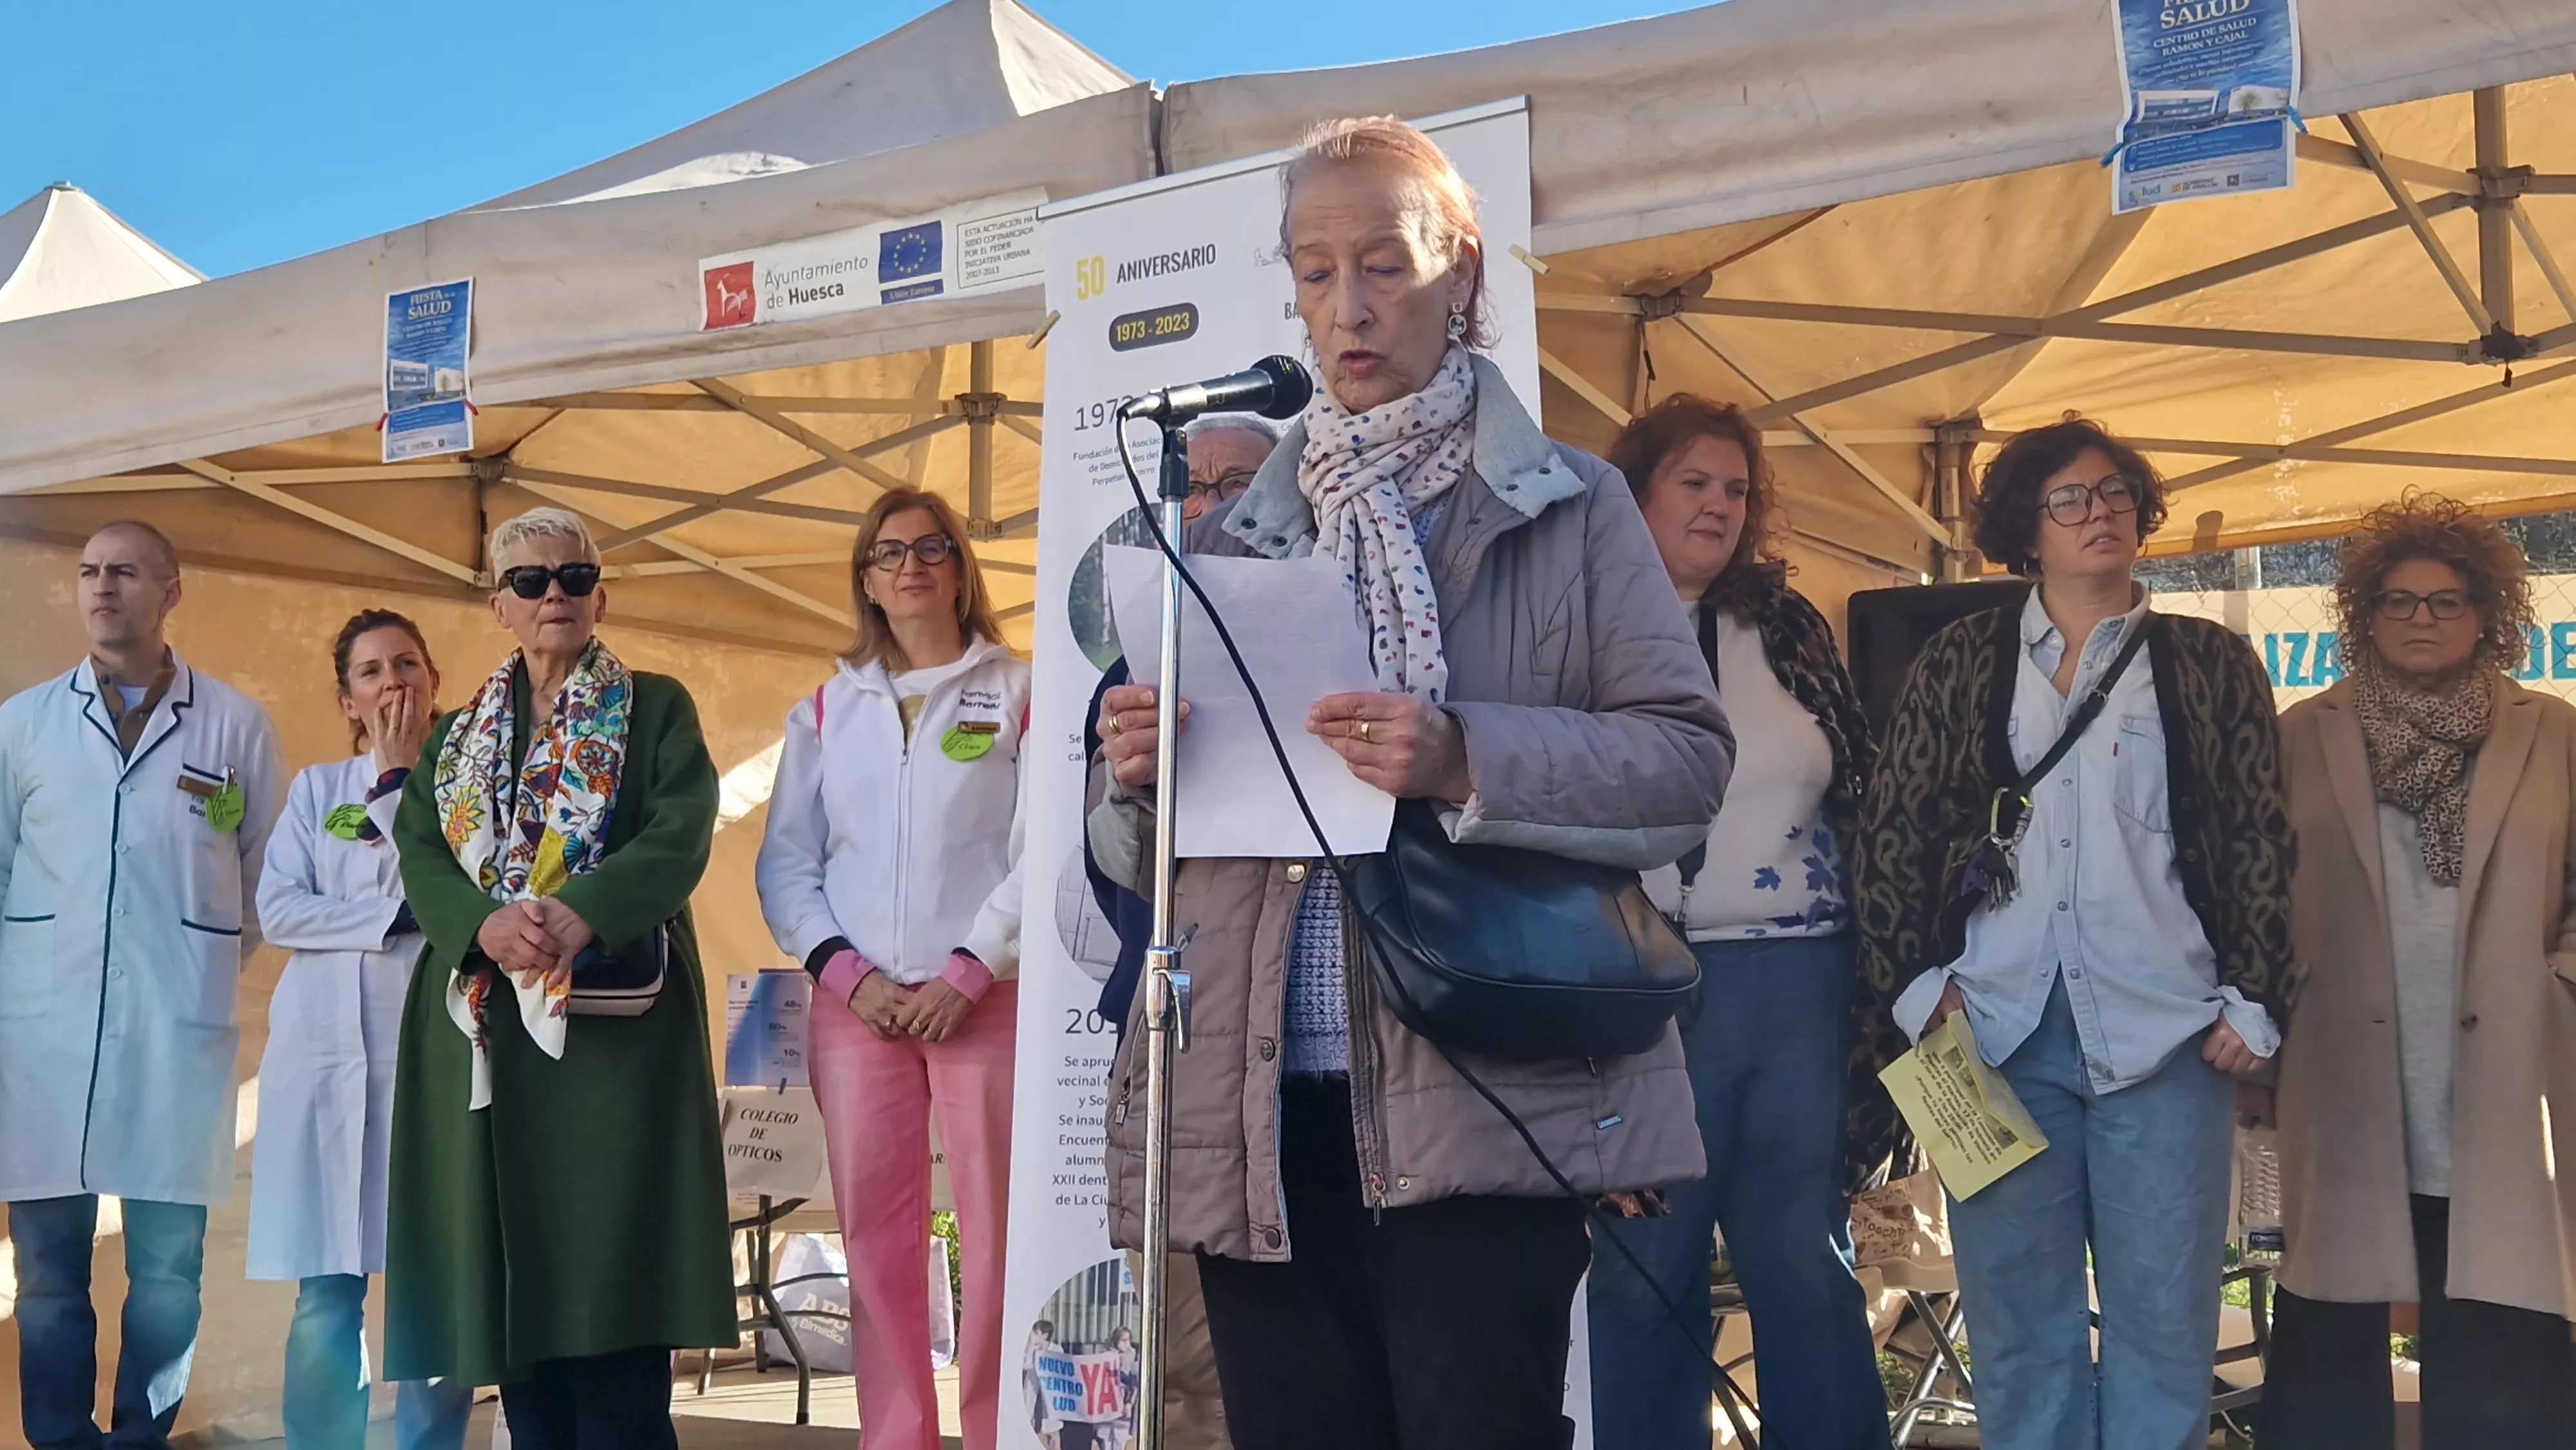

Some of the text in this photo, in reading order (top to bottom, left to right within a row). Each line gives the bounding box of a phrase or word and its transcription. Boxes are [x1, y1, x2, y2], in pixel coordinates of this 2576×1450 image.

[2160, 0, 2249, 29] SALUD
[2154, 18, 2257, 48] CENTRO DE SALUD
[2206, 38, 2213, 46] Y
[2215, 30, 2248, 44] CAJAL
[965, 228, 981, 237] ESTA
[1024, 216, 1033, 224] HA
[965, 238, 982, 247] SIDO
[965, 249, 978, 258] POR
[990, 241, 1011, 253] FEDER
[764, 256, 868, 290] Ayuntamiento
[966, 266, 999, 279] 2007-2013
[1077, 243, 1216, 301] 50 ANIVERSARIO
[411, 290, 444, 306] FIESTA
[767, 283, 845, 309] de Huesca
[408, 300, 451, 321] SALUD
[1116, 321, 1146, 343] 1973
[1155, 312, 1190, 335] 2023
[1073, 446, 1113, 461] Fundación
[1146, 450, 1159, 460] del
[2239, 632, 2349, 687] IZA
[1069, 734, 1082, 744] Se
[1065, 1008, 1119, 1034] 20
[1065, 1056, 1079, 1066] Se
[1057, 1075, 1101, 1086] vecinal
[1079, 1097, 1086, 1108] y
[741, 1107, 799, 1124] COLEGIO
[1059, 1115, 1103, 1125] Se inau
[748, 1127, 769, 1140] DE
[728, 1144, 783, 1163] OPTICOS
[1065, 1154, 1104, 1165] alumn
[1052, 1174, 1107, 1185] XXII dent
[1056, 1194, 1071, 1205] de
[1074, 1194, 1088, 1205] La
[1099, 1217, 1106, 1228] y
[1039, 1357, 1075, 1377] NUEVO
[1041, 1377, 1083, 1397] ENTRO
[1080, 1361, 1118, 1416] YA
